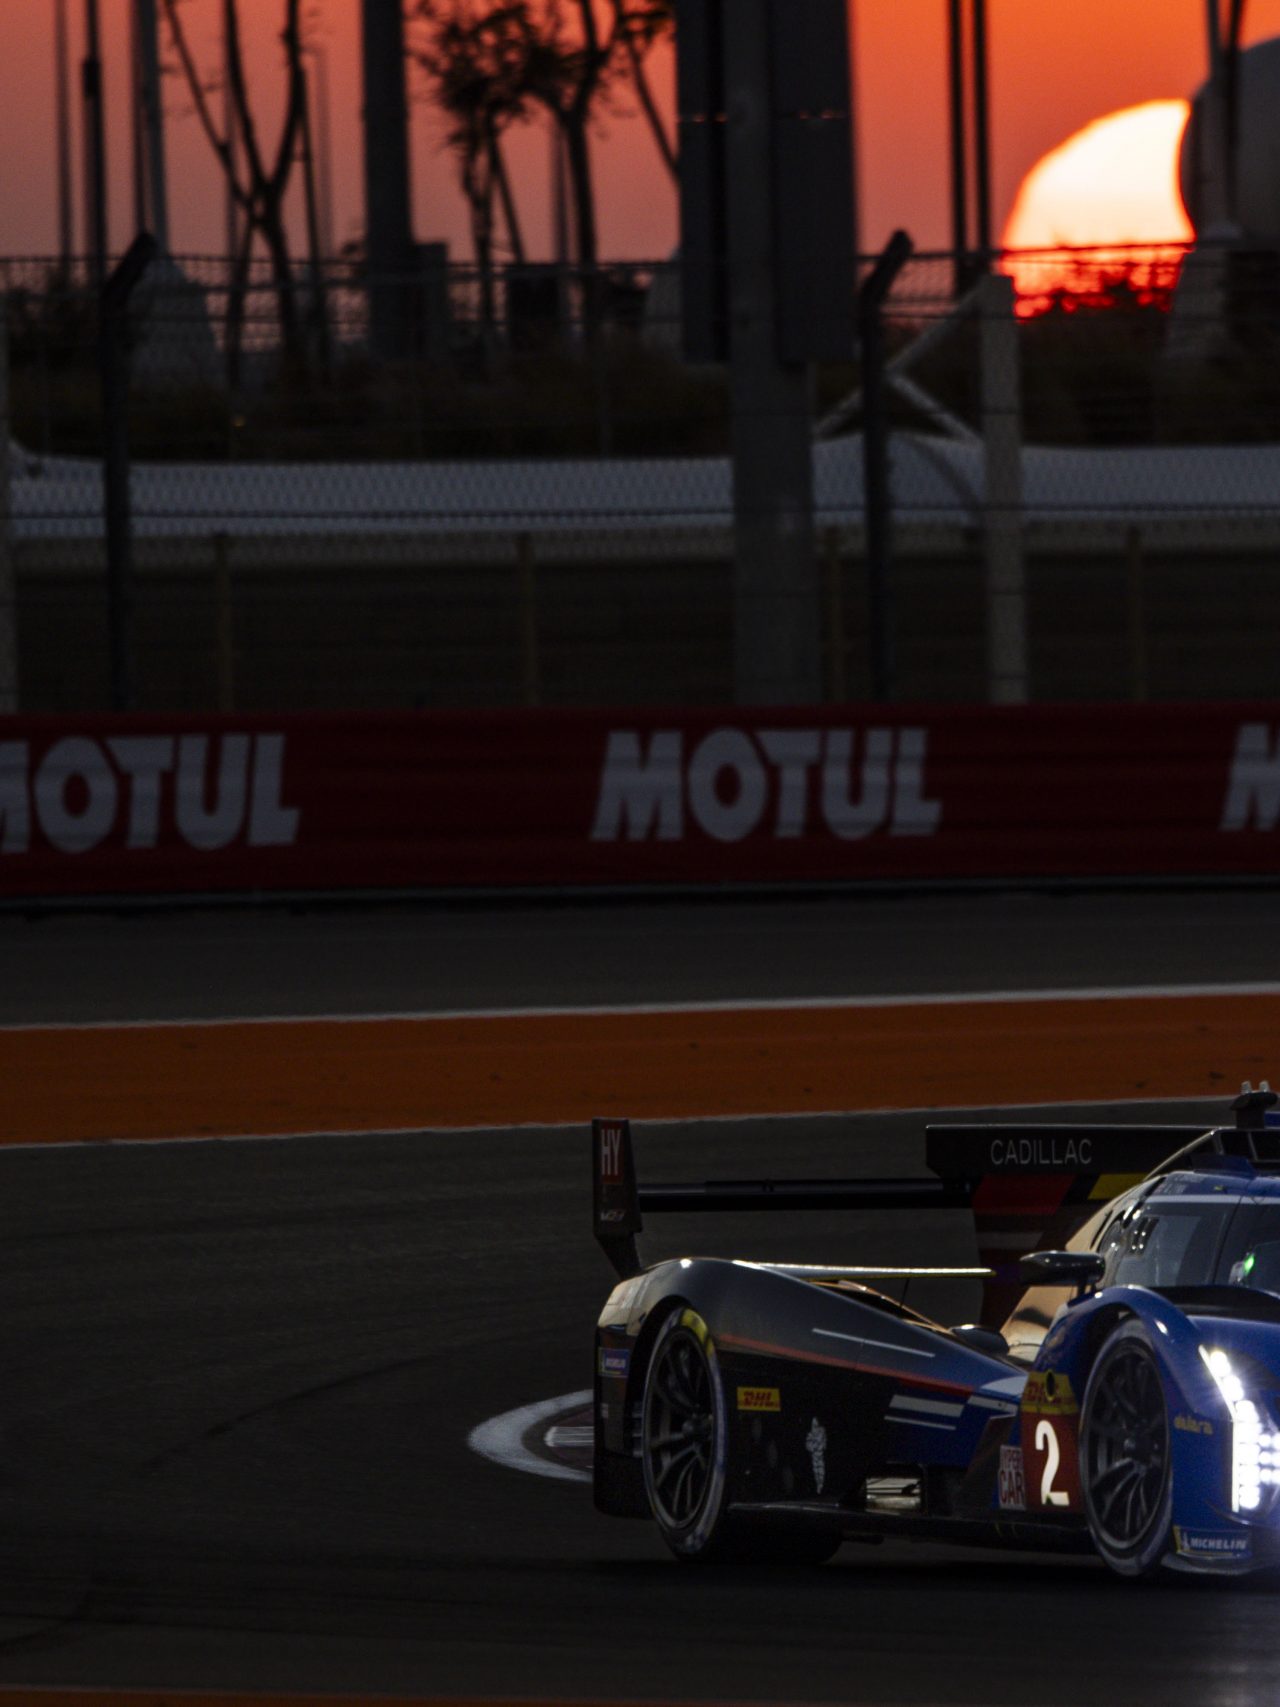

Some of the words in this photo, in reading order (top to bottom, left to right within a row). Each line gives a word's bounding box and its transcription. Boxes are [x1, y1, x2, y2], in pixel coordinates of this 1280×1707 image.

[589, 726, 943, 844] MOTUL
[601, 1129, 621, 1176] HY
[990, 1138, 1093, 1165] CADILLAC
[743, 1391, 775, 1407] DHL
[1034, 1419, 1070, 1507] 2
[1001, 1470, 1025, 1504] CAR
[1190, 1536, 1248, 1550] MICHELIN
